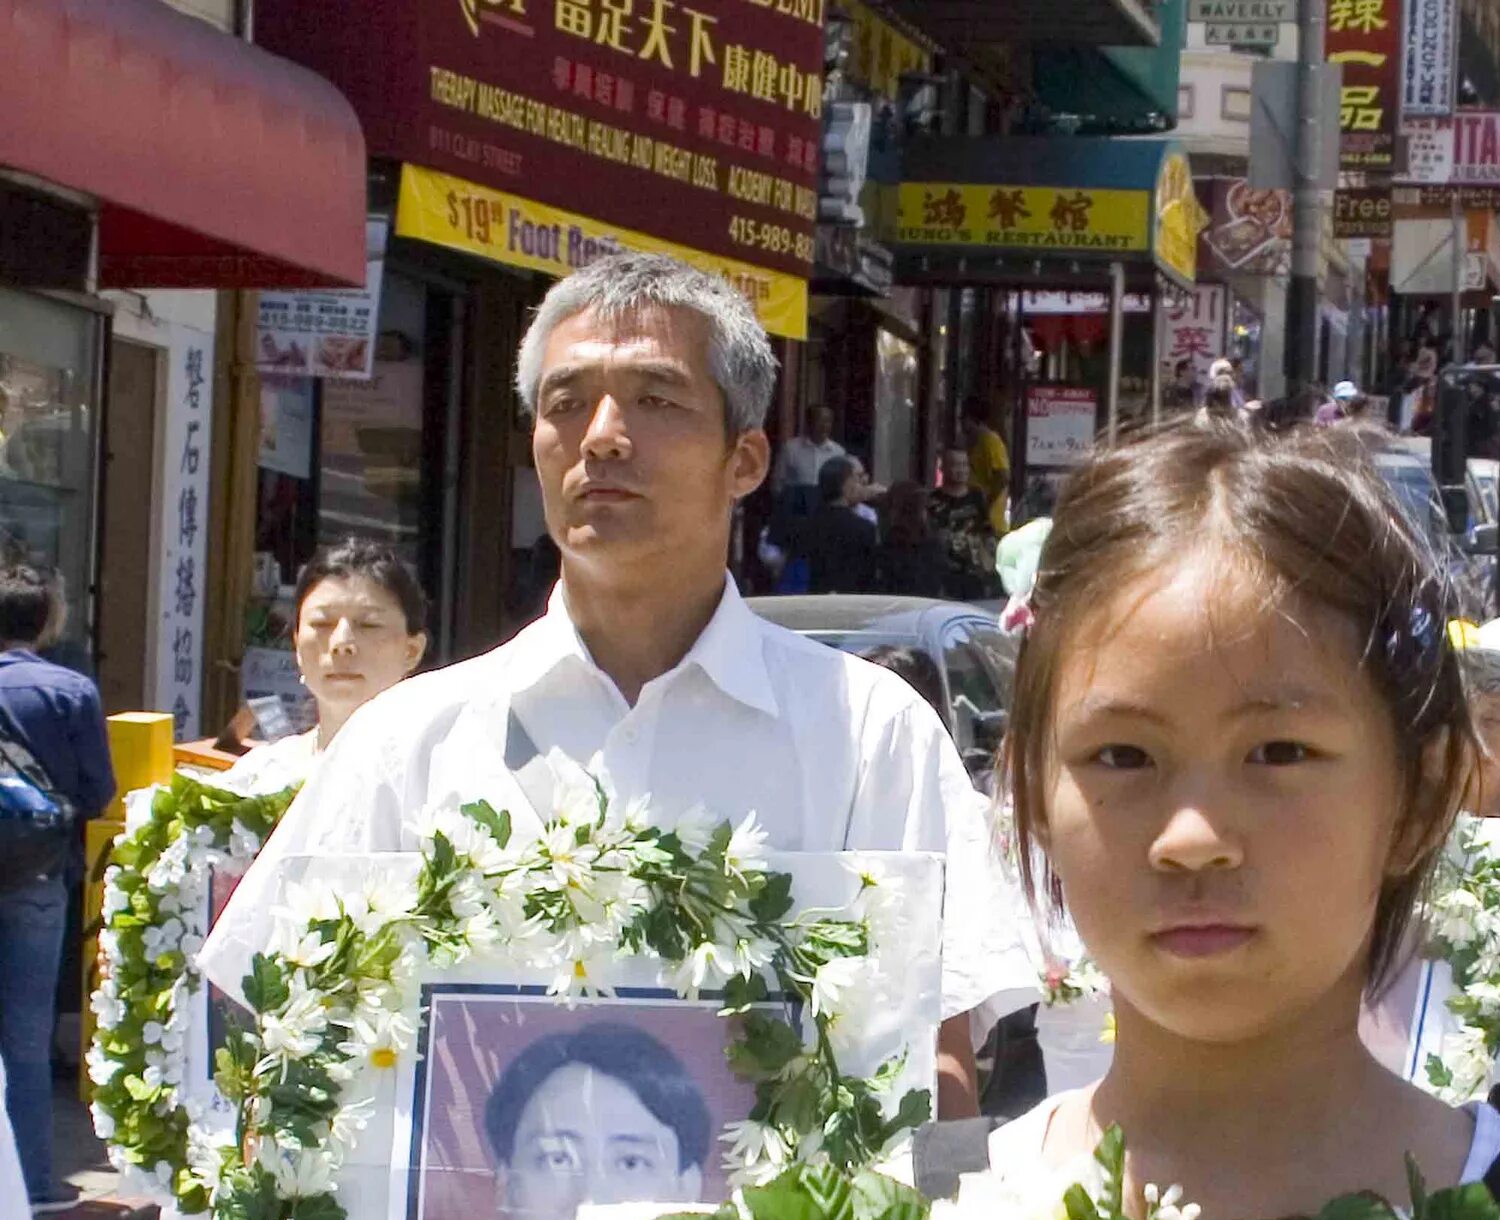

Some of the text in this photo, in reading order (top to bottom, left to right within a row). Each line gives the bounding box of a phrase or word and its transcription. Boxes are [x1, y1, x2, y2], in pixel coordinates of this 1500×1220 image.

[1200, 1, 1285, 17] WAVERLY
[430, 66, 476, 113] THERAPY
[476, 81, 525, 129] MASSAGE
[525, 98, 546, 136] FOR
[586, 119, 632, 165] HEALING
[631, 133, 654, 169] AND
[654, 140, 692, 181] WEIGHT
[727, 164, 773, 205] ACADEMY
[774, 177, 794, 212] FOR
[1337, 196, 1391, 217] Free
[509, 208, 560, 265] Foot
[985, 230, 1135, 249] RESTAURANT
